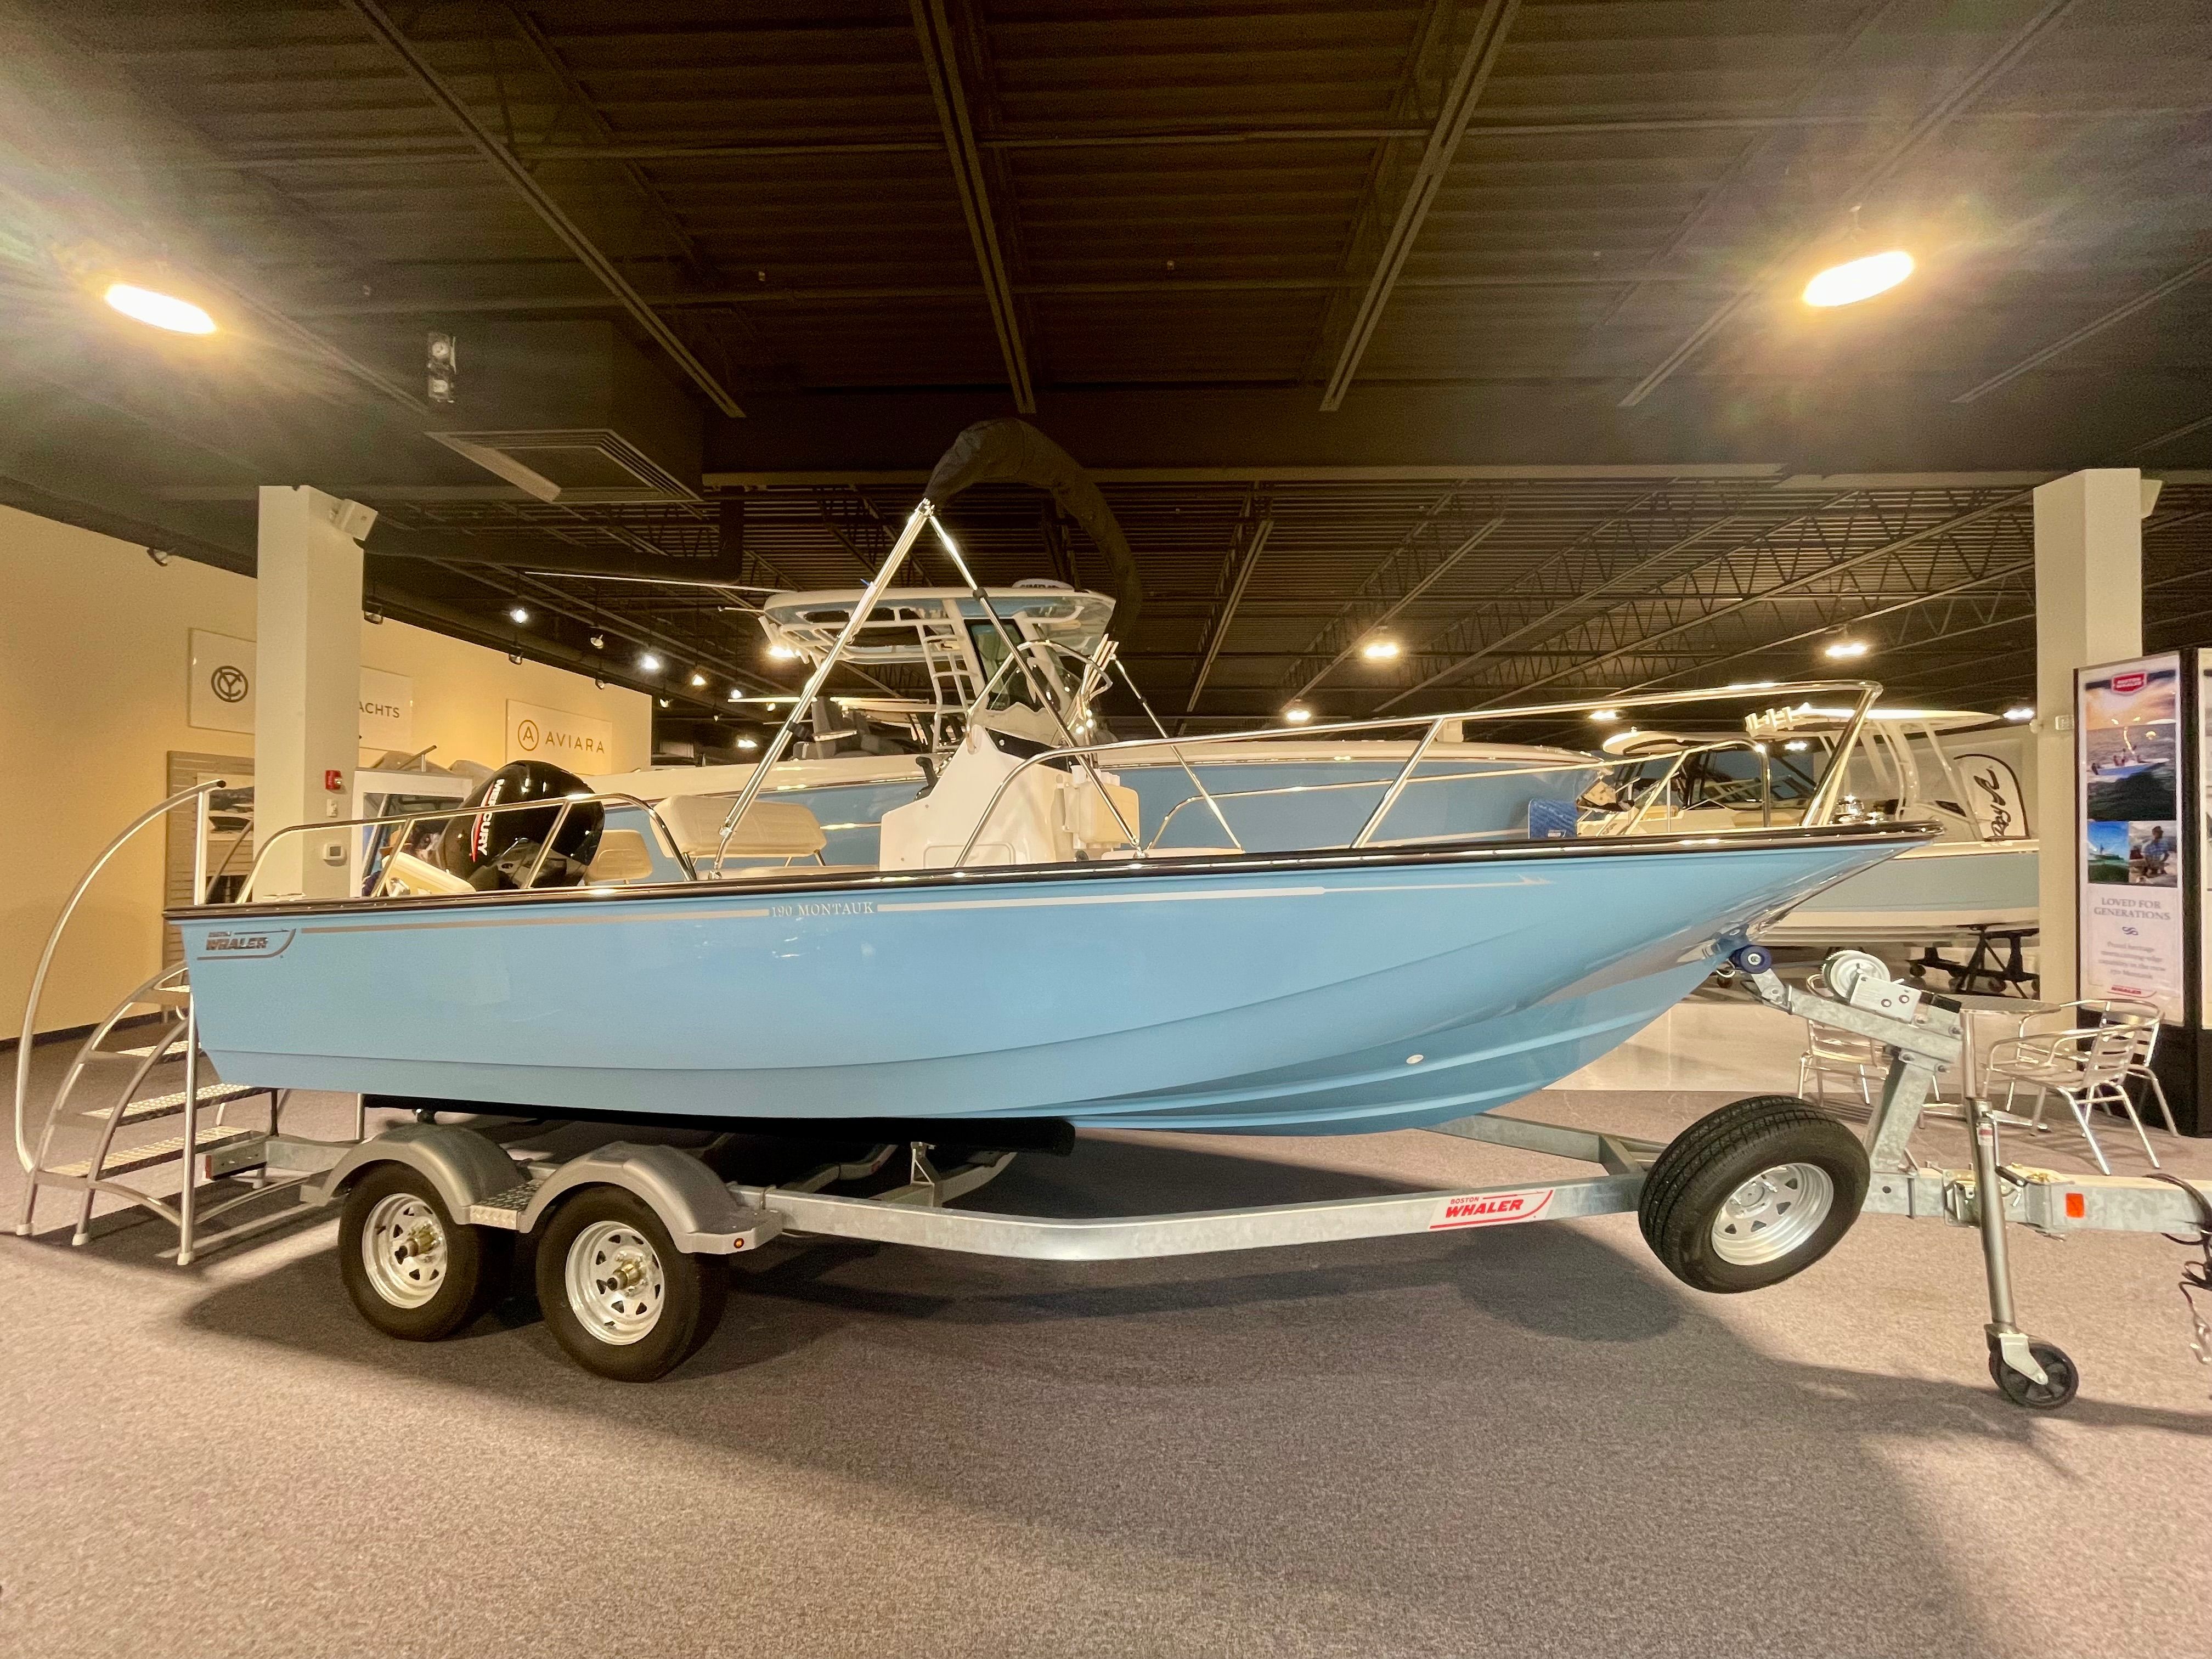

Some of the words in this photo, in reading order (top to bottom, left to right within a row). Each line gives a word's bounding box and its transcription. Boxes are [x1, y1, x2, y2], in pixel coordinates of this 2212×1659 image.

[359, 701, 400, 718] ACHTS
[545, 731, 605, 754] AVIARA
[772, 906, 792, 918] 190
[798, 901, 874, 917] MONTAUK
[2101, 897, 2136, 907] LOVED
[2140, 900, 2161, 909] FOR
[2094, 907, 2171, 920] GENERATIONS
[1445, 1199, 1524, 1218] WHALER
[1450, 1197, 1480, 1205] BOSTON
